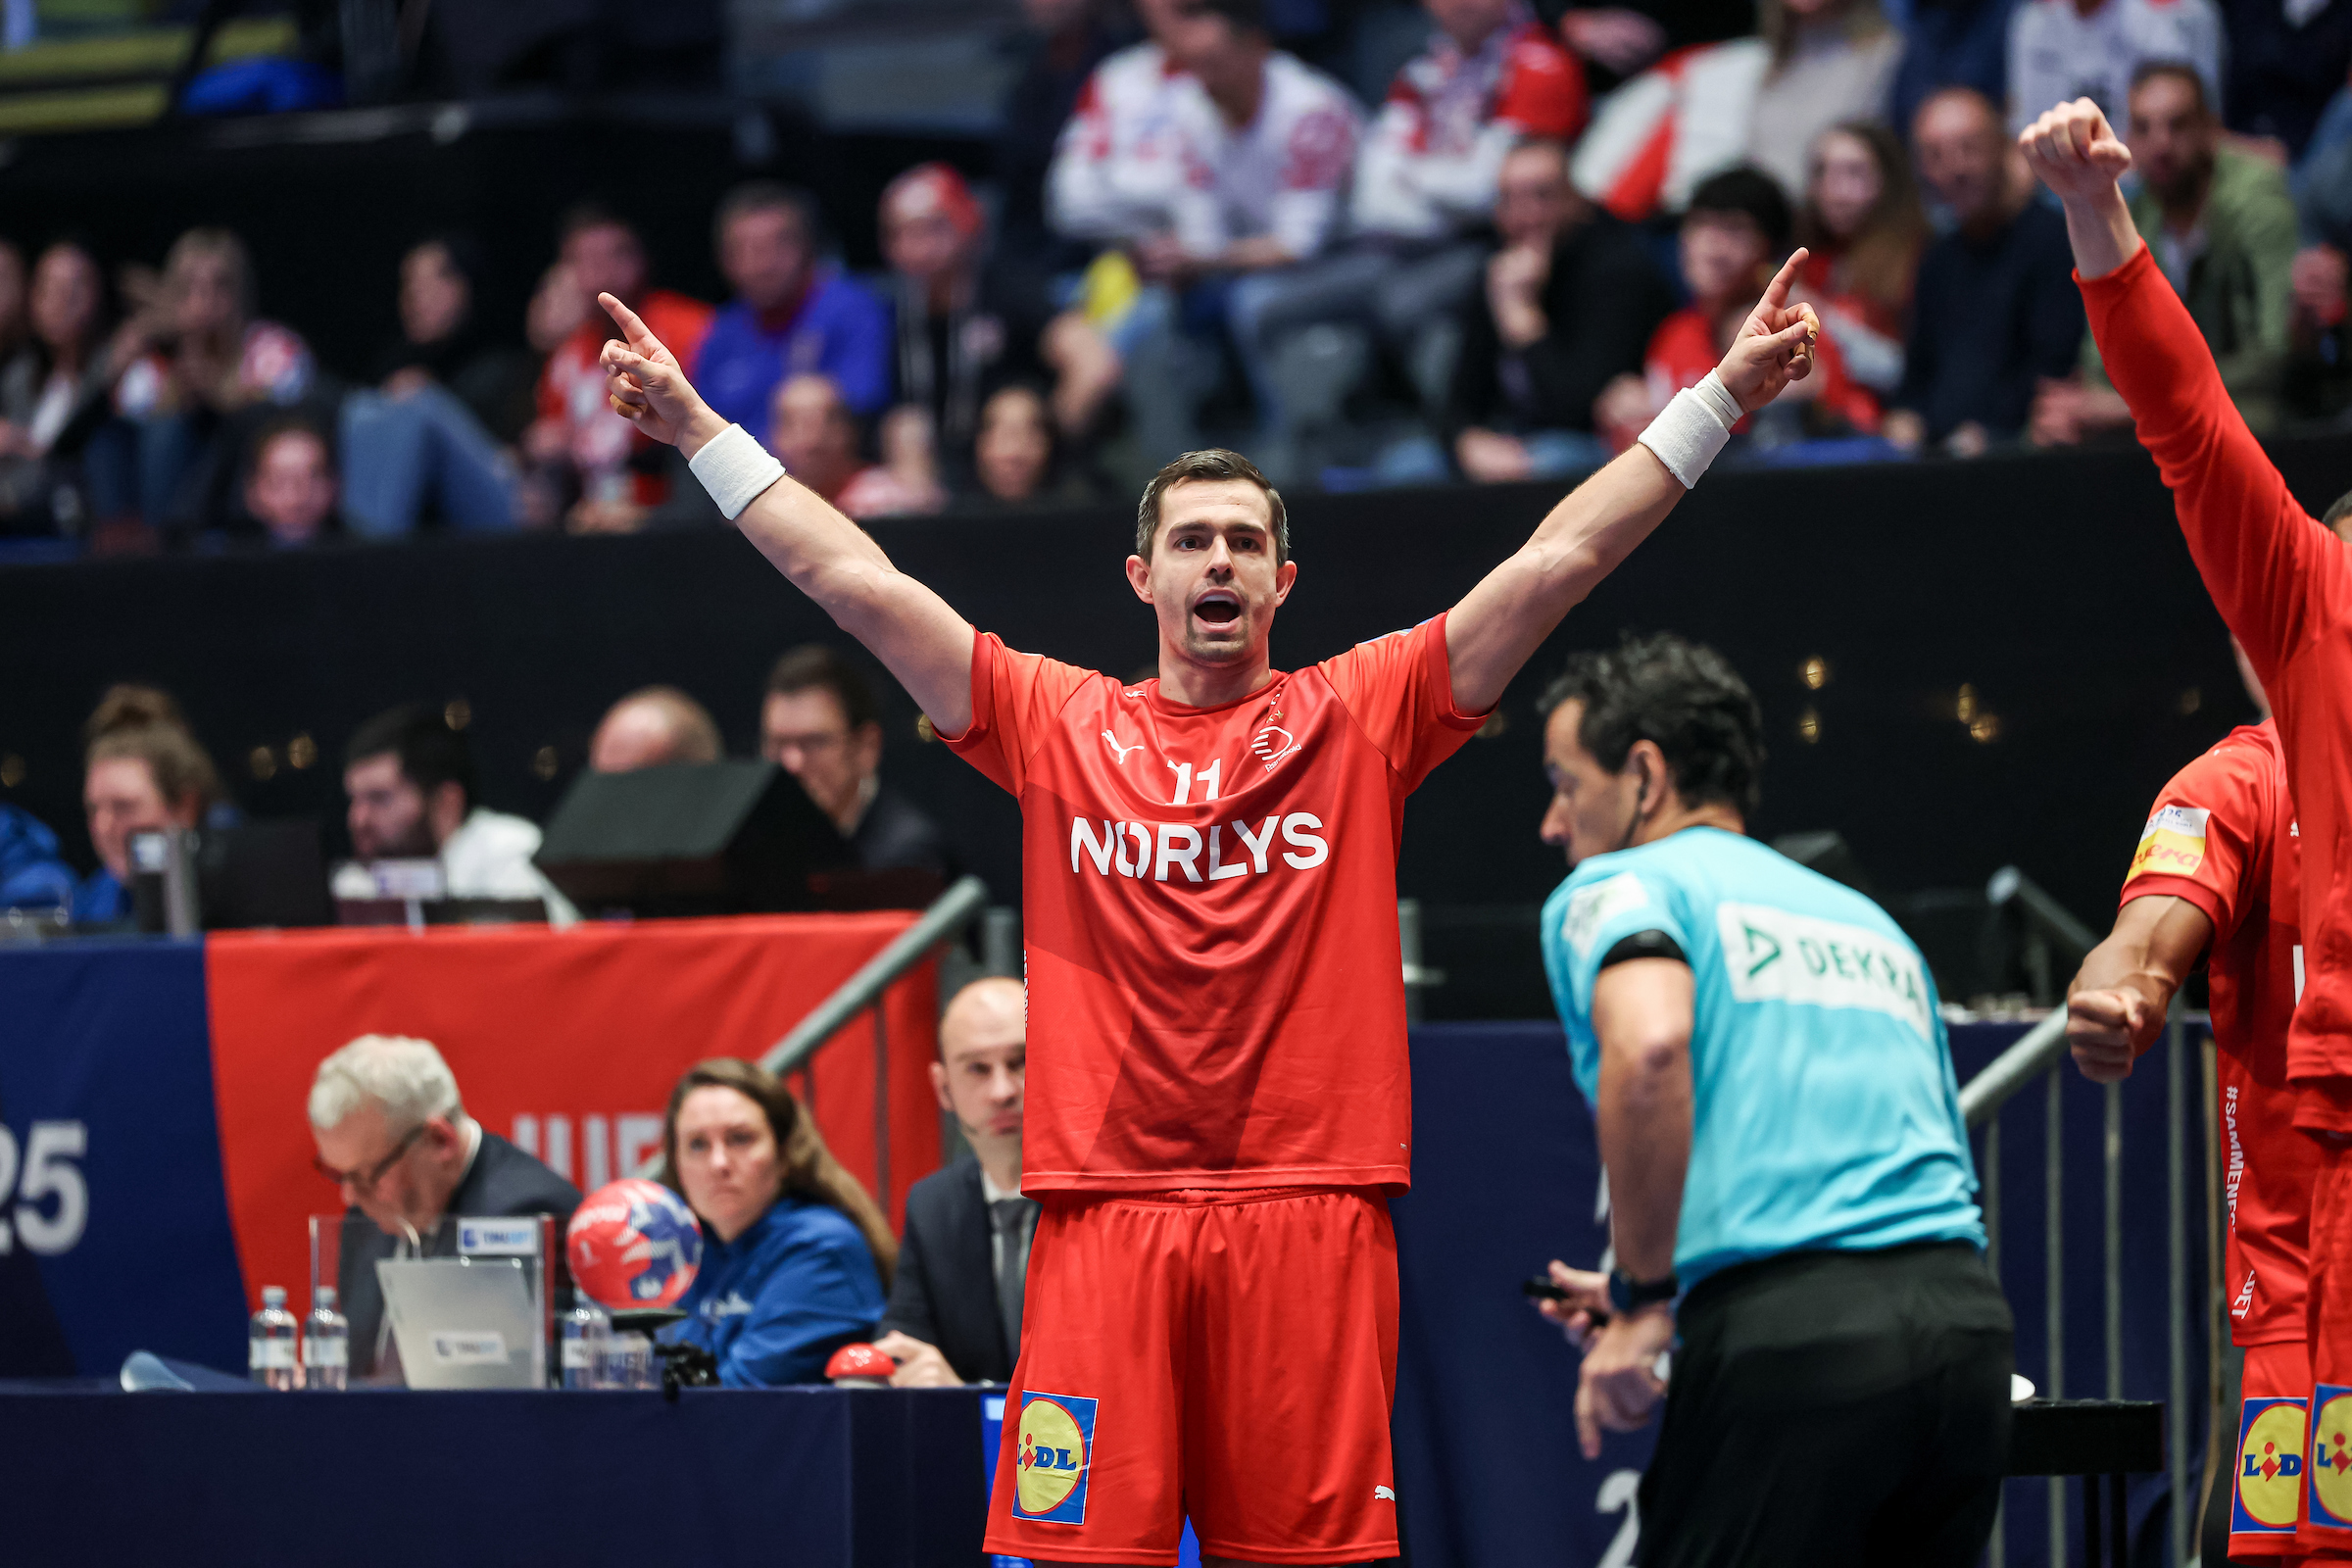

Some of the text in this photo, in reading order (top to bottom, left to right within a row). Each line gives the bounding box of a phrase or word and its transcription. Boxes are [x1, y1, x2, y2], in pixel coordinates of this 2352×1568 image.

[1165, 759, 1221, 806] 11
[1071, 811, 1329, 882] NORLYS
[1797, 937, 1923, 1009] DEKRA
[0, 1119, 89, 1255] 5
